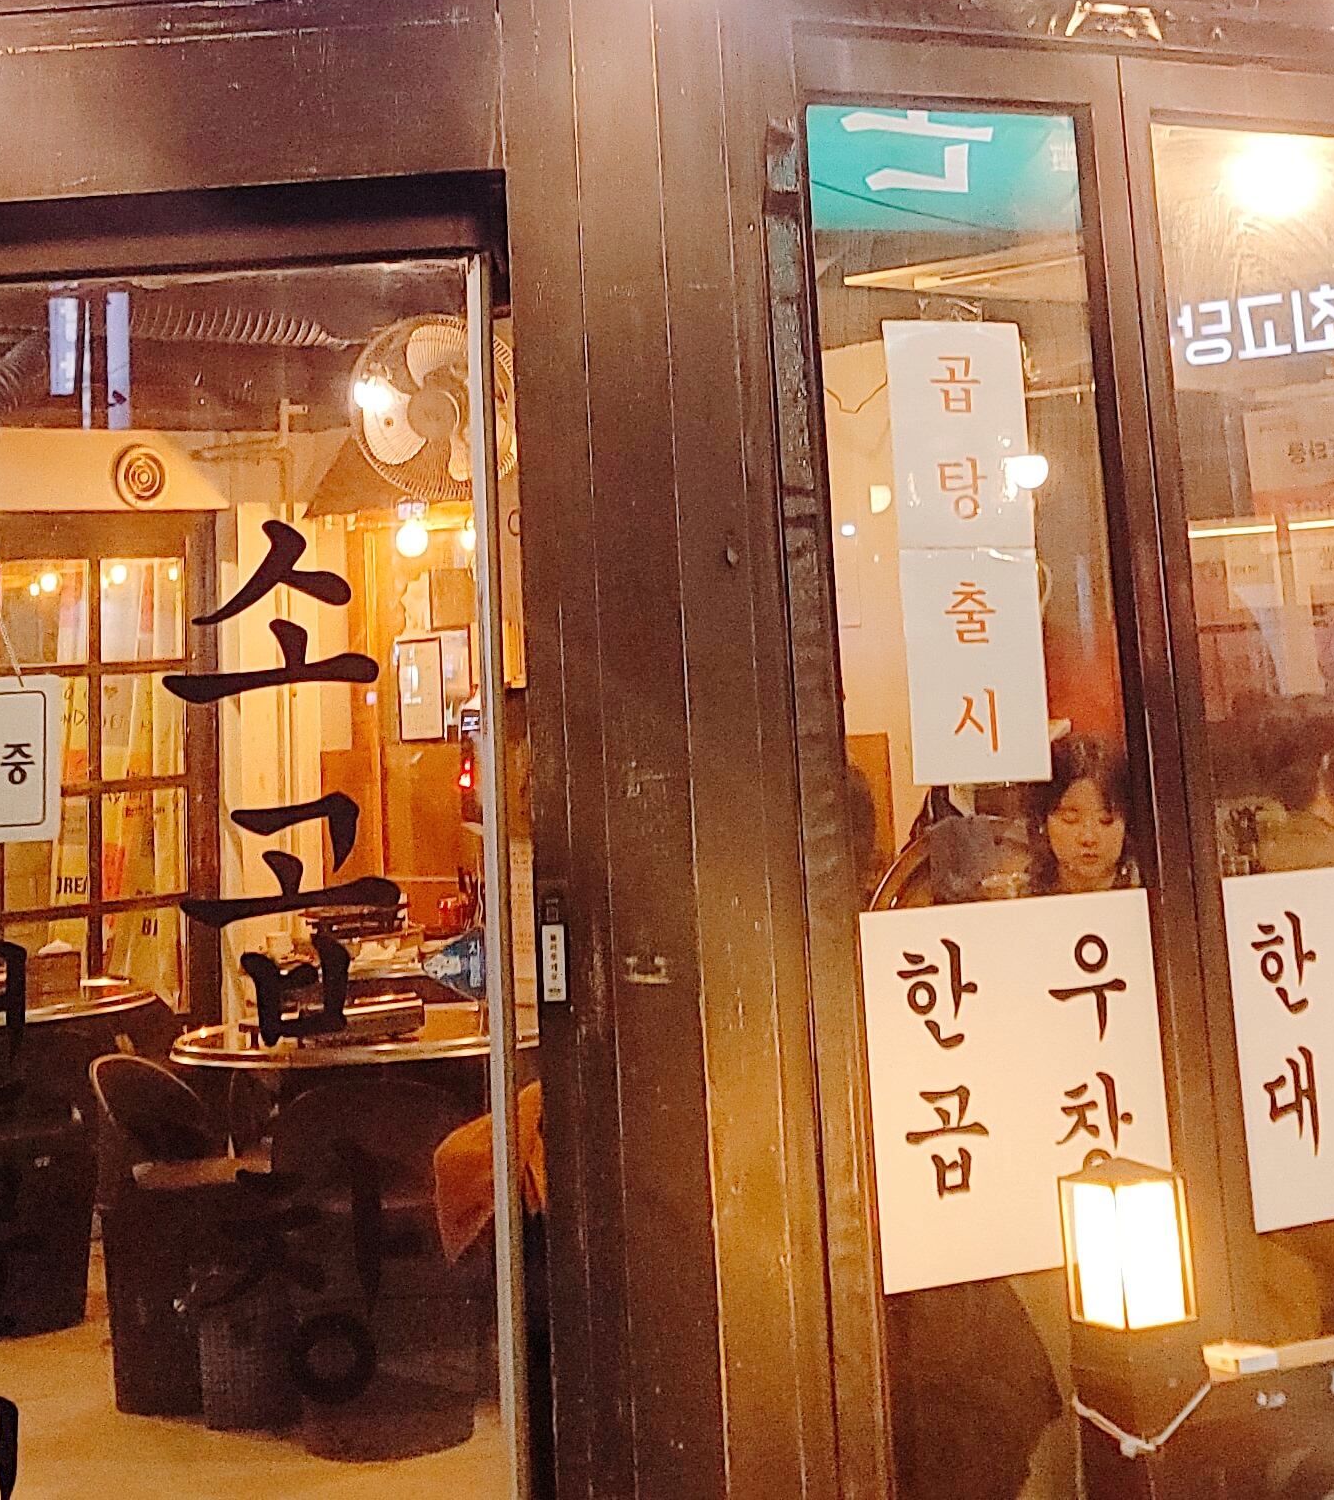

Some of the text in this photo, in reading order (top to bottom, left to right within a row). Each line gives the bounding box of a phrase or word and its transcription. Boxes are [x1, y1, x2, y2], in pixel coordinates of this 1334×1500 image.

[929, 353, 1001, 754] 곱탕 출시
[897, 934, 1127, 1050] 한우
[905, 1072, 1134, 1200] 곱창
